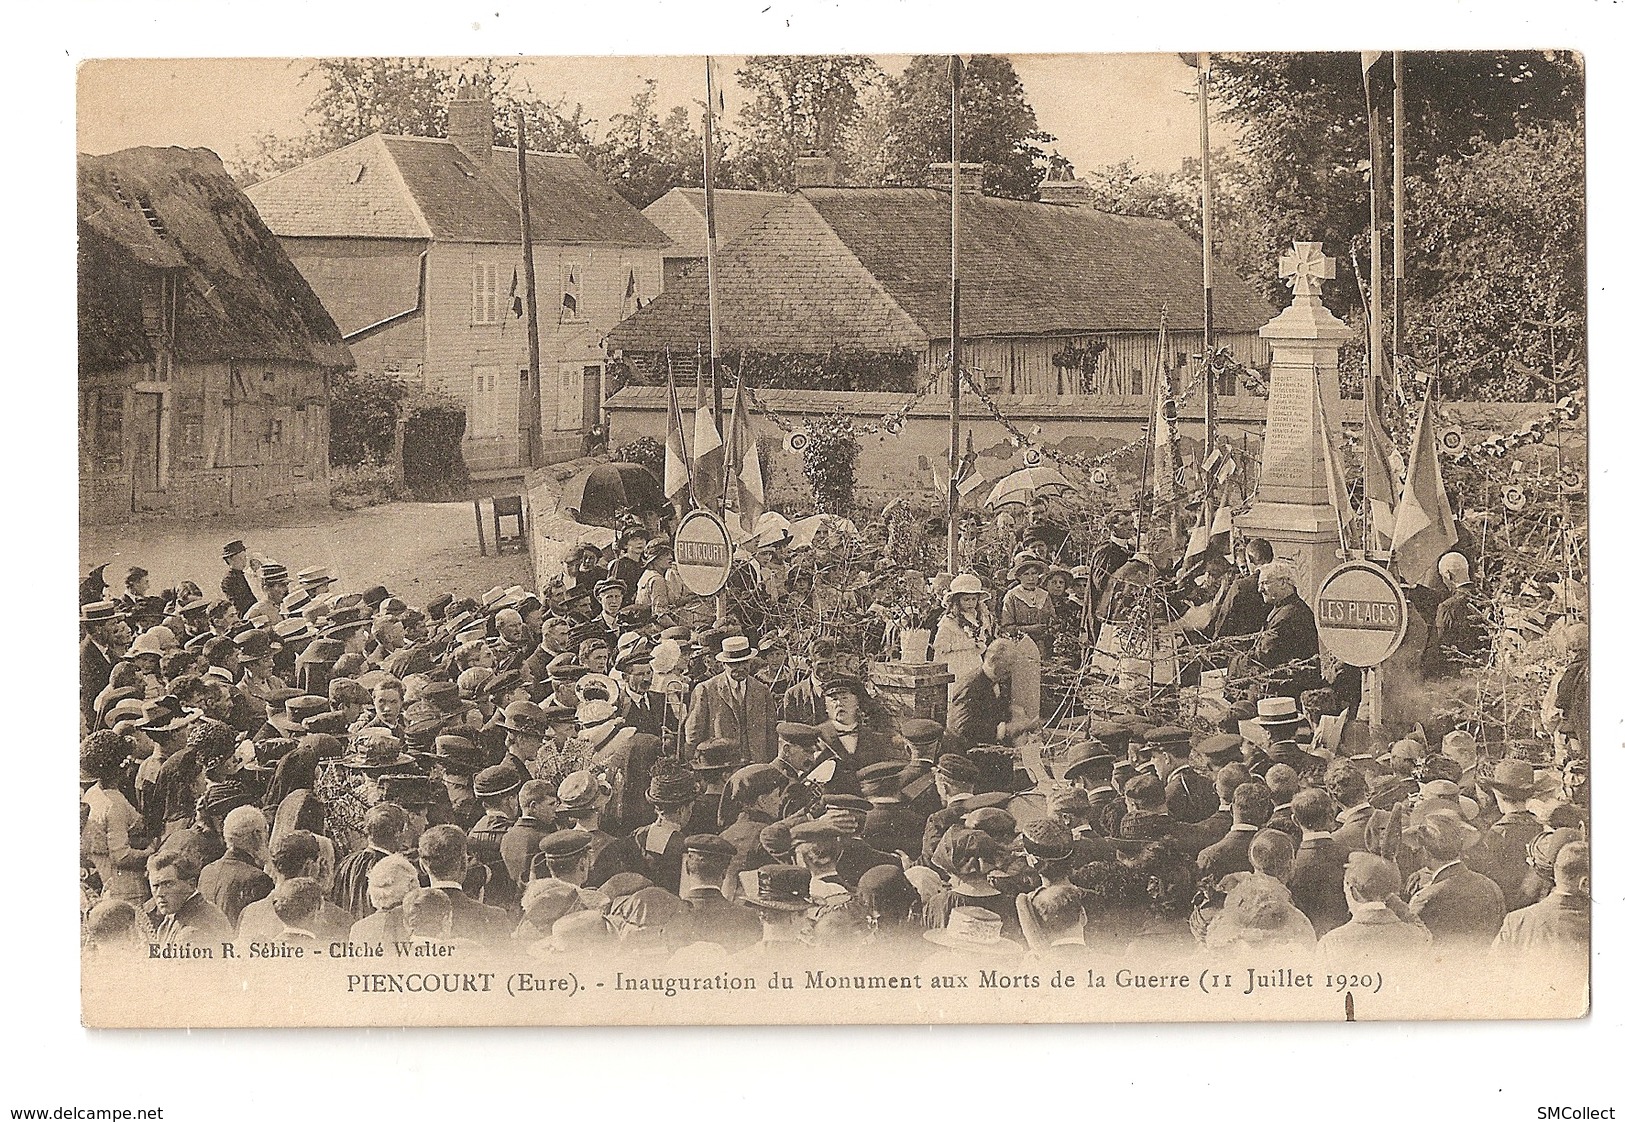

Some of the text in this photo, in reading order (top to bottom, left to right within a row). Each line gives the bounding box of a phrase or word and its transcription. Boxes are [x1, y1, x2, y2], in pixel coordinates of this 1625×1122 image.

[678, 542, 723, 561] PIENCOURT
[1321, 601, 1397, 624] LES PLACES
